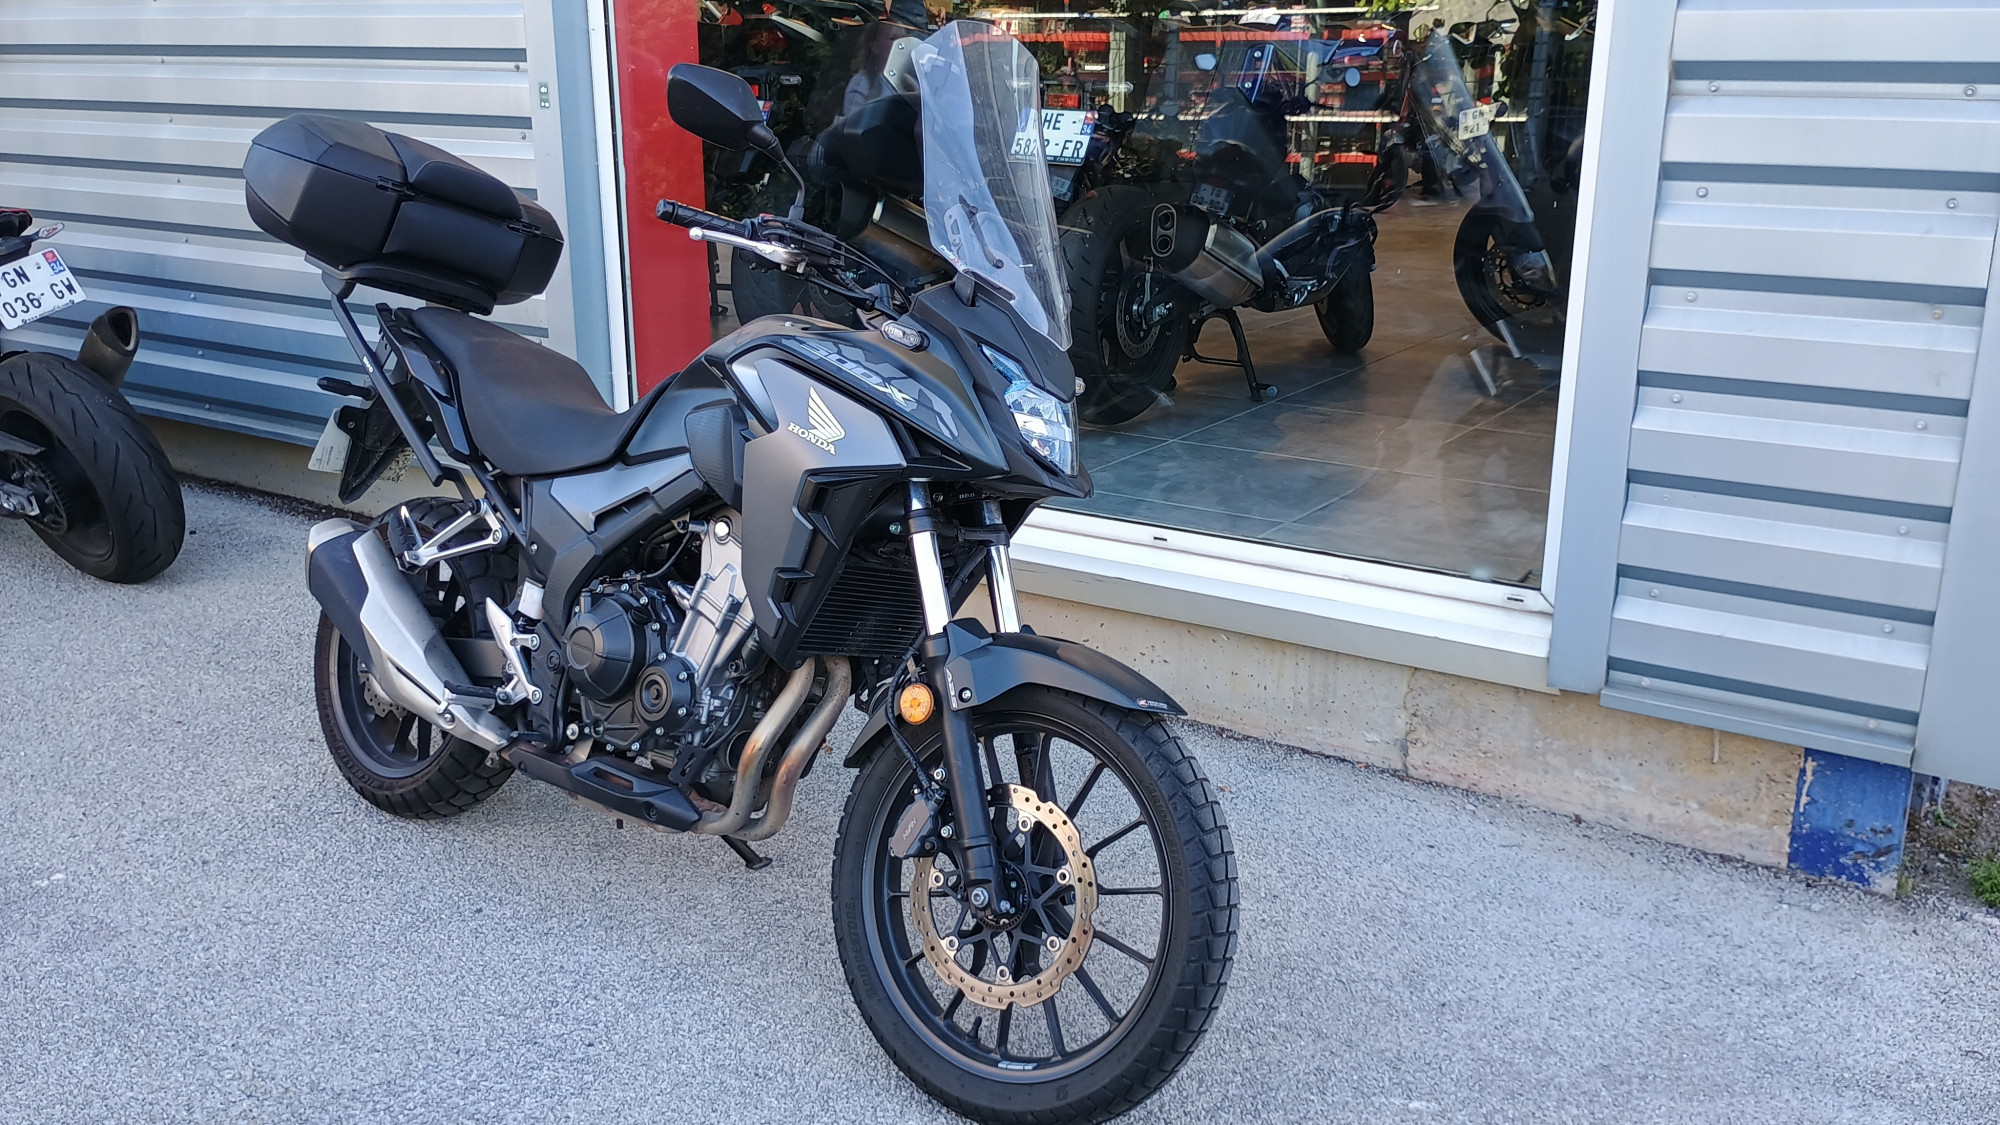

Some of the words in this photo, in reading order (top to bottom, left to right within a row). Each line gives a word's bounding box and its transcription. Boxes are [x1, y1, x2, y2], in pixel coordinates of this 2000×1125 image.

[1081, 124, 1091, 134] 34
[50, 262, 64, 274] 34
[787, 421, 836, 455] HONDA
